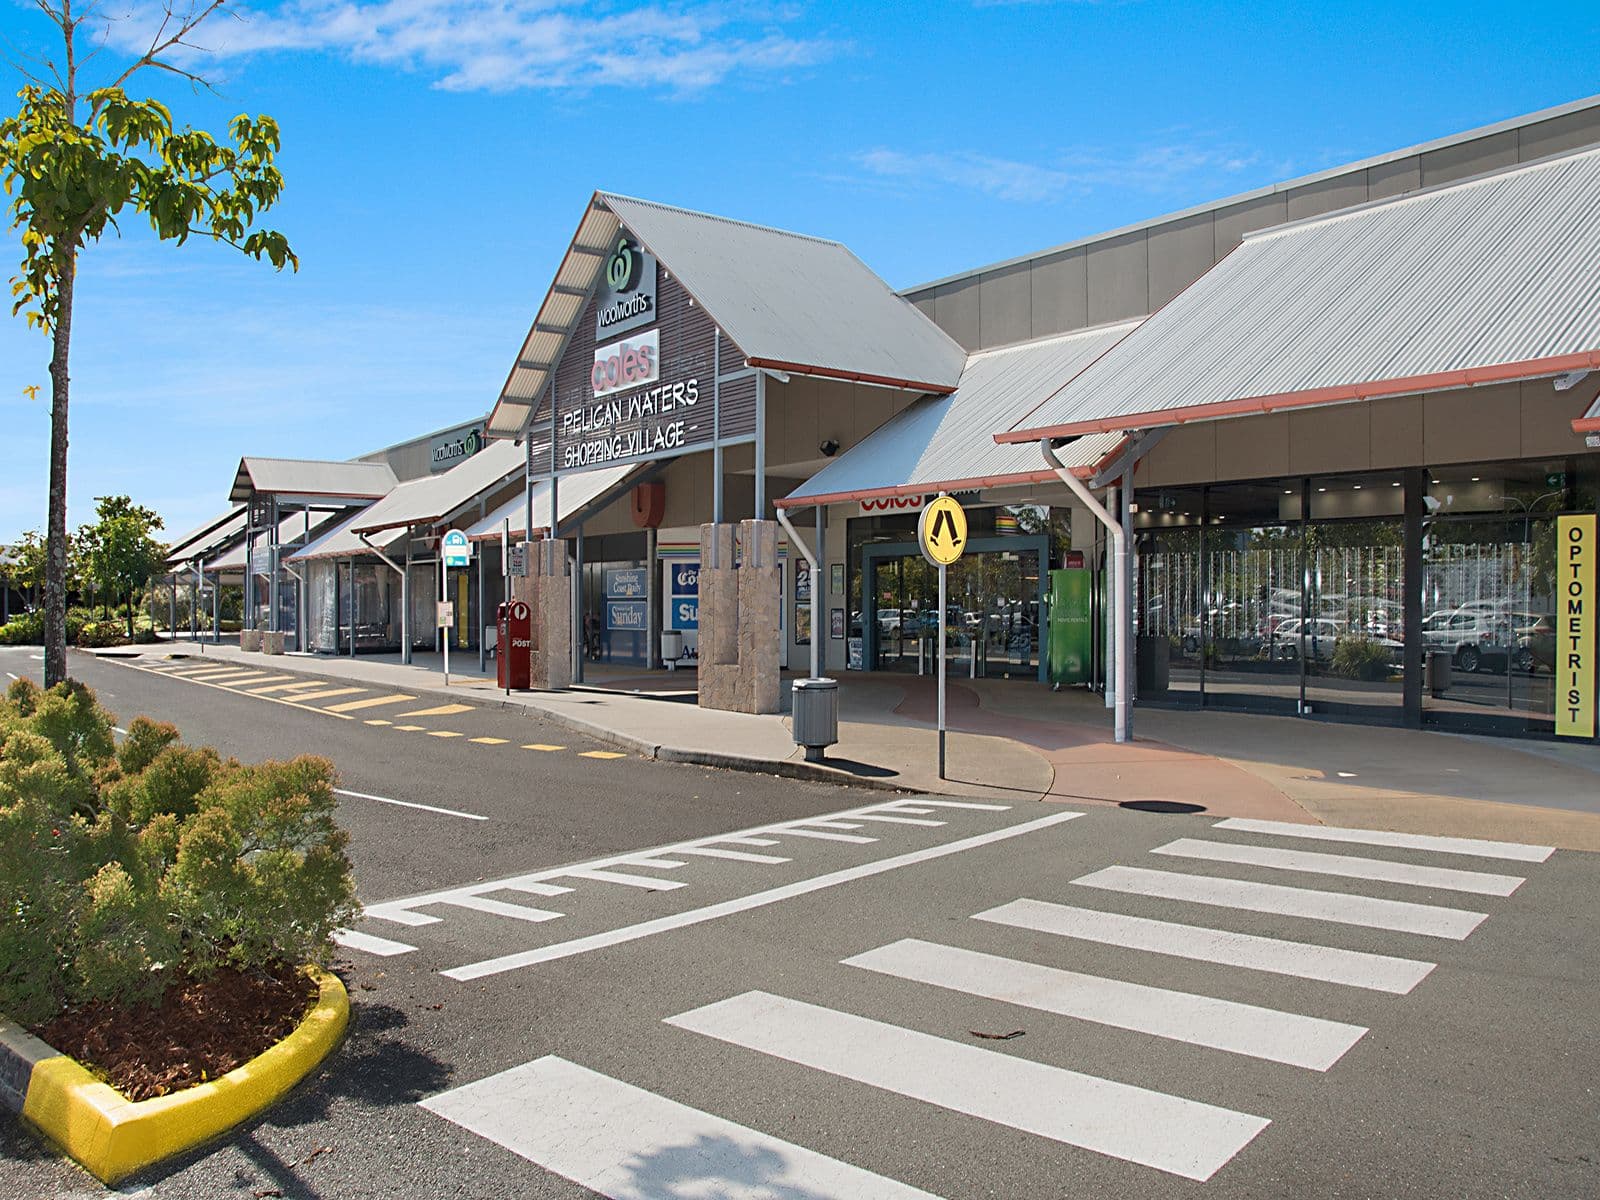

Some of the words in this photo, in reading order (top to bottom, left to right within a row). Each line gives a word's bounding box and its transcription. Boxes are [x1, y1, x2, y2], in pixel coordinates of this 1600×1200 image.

[598, 295, 647, 327] Woolworths
[591, 343, 653, 391] coles
[564, 399, 622, 435] PELICAN
[628, 379, 699, 421] WATERS
[564, 435, 622, 468] SHOPPING
[628, 421, 685, 455] VILLAGE
[611, 606, 643, 628] Sunday
[1568, 527, 1583, 723] OPTOMETRIST
[512, 639, 531, 648] POST
